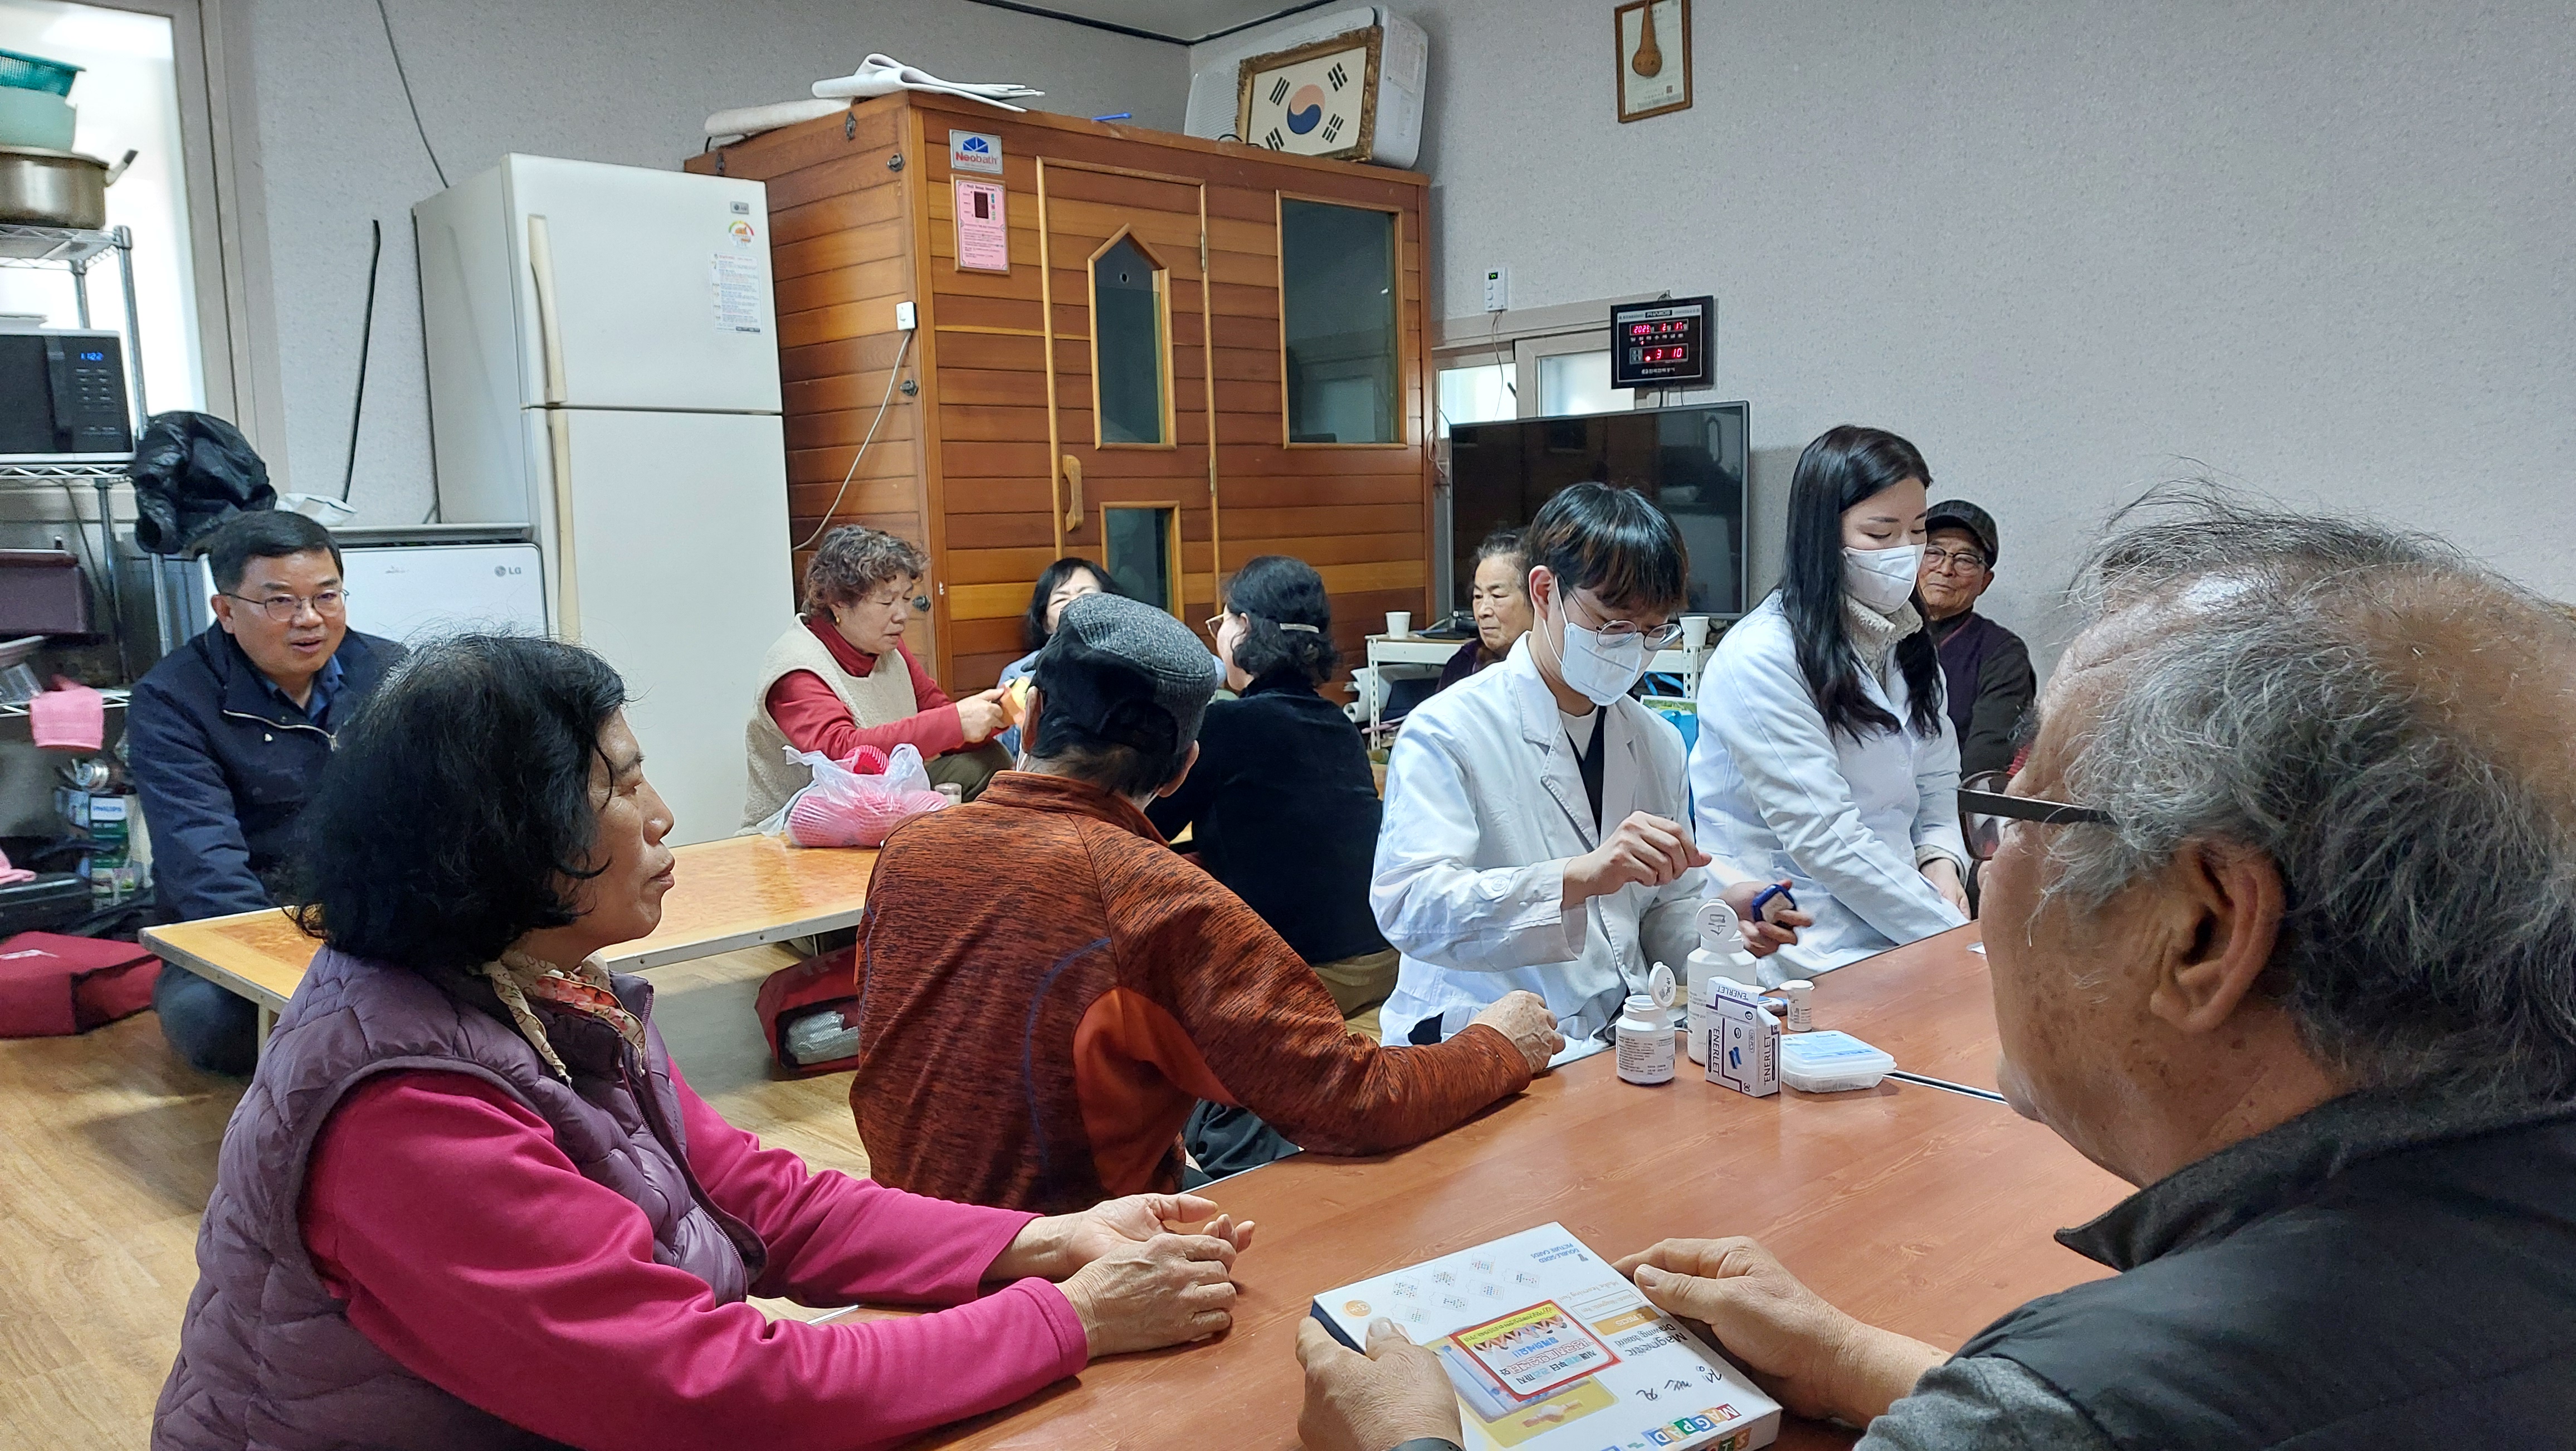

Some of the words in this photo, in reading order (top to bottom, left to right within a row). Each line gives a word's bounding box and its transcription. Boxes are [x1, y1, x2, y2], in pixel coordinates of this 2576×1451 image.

[955, 152, 997, 164] Neobath
[1656, 348, 1662, 359] 3
[1674, 348, 1682, 358] 10
[509, 567, 521, 575] LG
[1744, 1083, 1750, 1092] 30
[1545, 1242, 1574, 1254] PICTURE
[1569, 1286, 1601, 1298] learning
[1613, 1314, 1639, 1326] PIECES
[1637, 1323, 1676, 1338] Drawing
[1511, 1336, 1559, 1357] 함께하세요!!
[1623, 1332, 1689, 1356] Magnetic
[1649, 1406, 1739, 1443] MAGPAD
